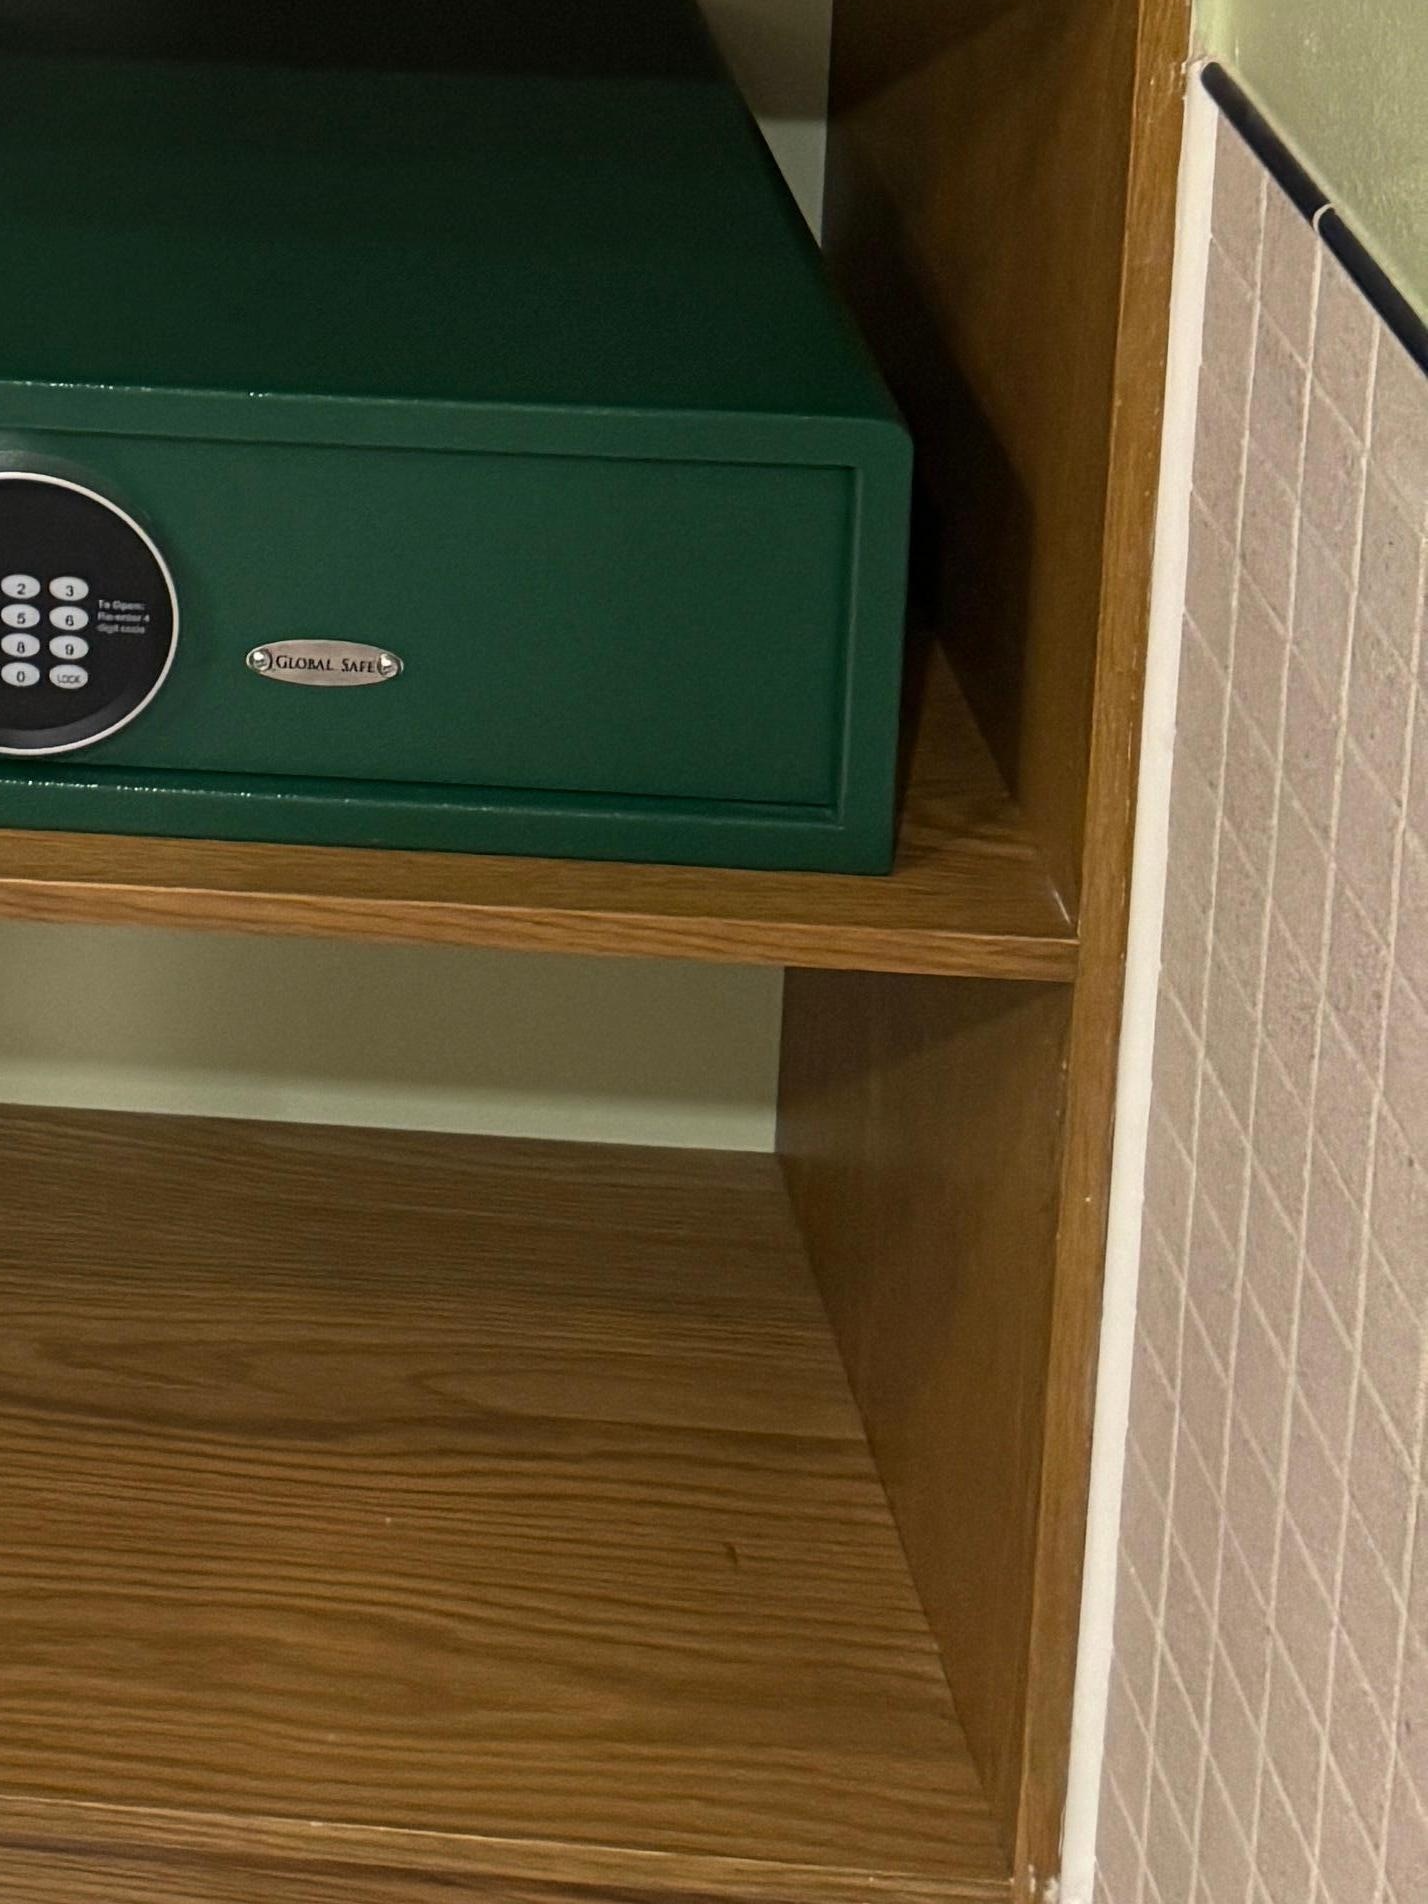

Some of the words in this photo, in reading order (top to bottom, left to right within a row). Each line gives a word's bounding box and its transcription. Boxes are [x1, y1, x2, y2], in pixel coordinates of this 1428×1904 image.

[16, 583, 26, 595] 2
[65, 585, 74, 597] 3
[17, 612, 26, 624] 5
[65, 615, 74, 627] 6
[16, 641, 25, 654] 8
[65, 644, 74, 656] 9
[276, 655, 333, 671] GLOBAL
[16, 671, 25, 683] 0
[57, 673, 81, 684] LOCK
